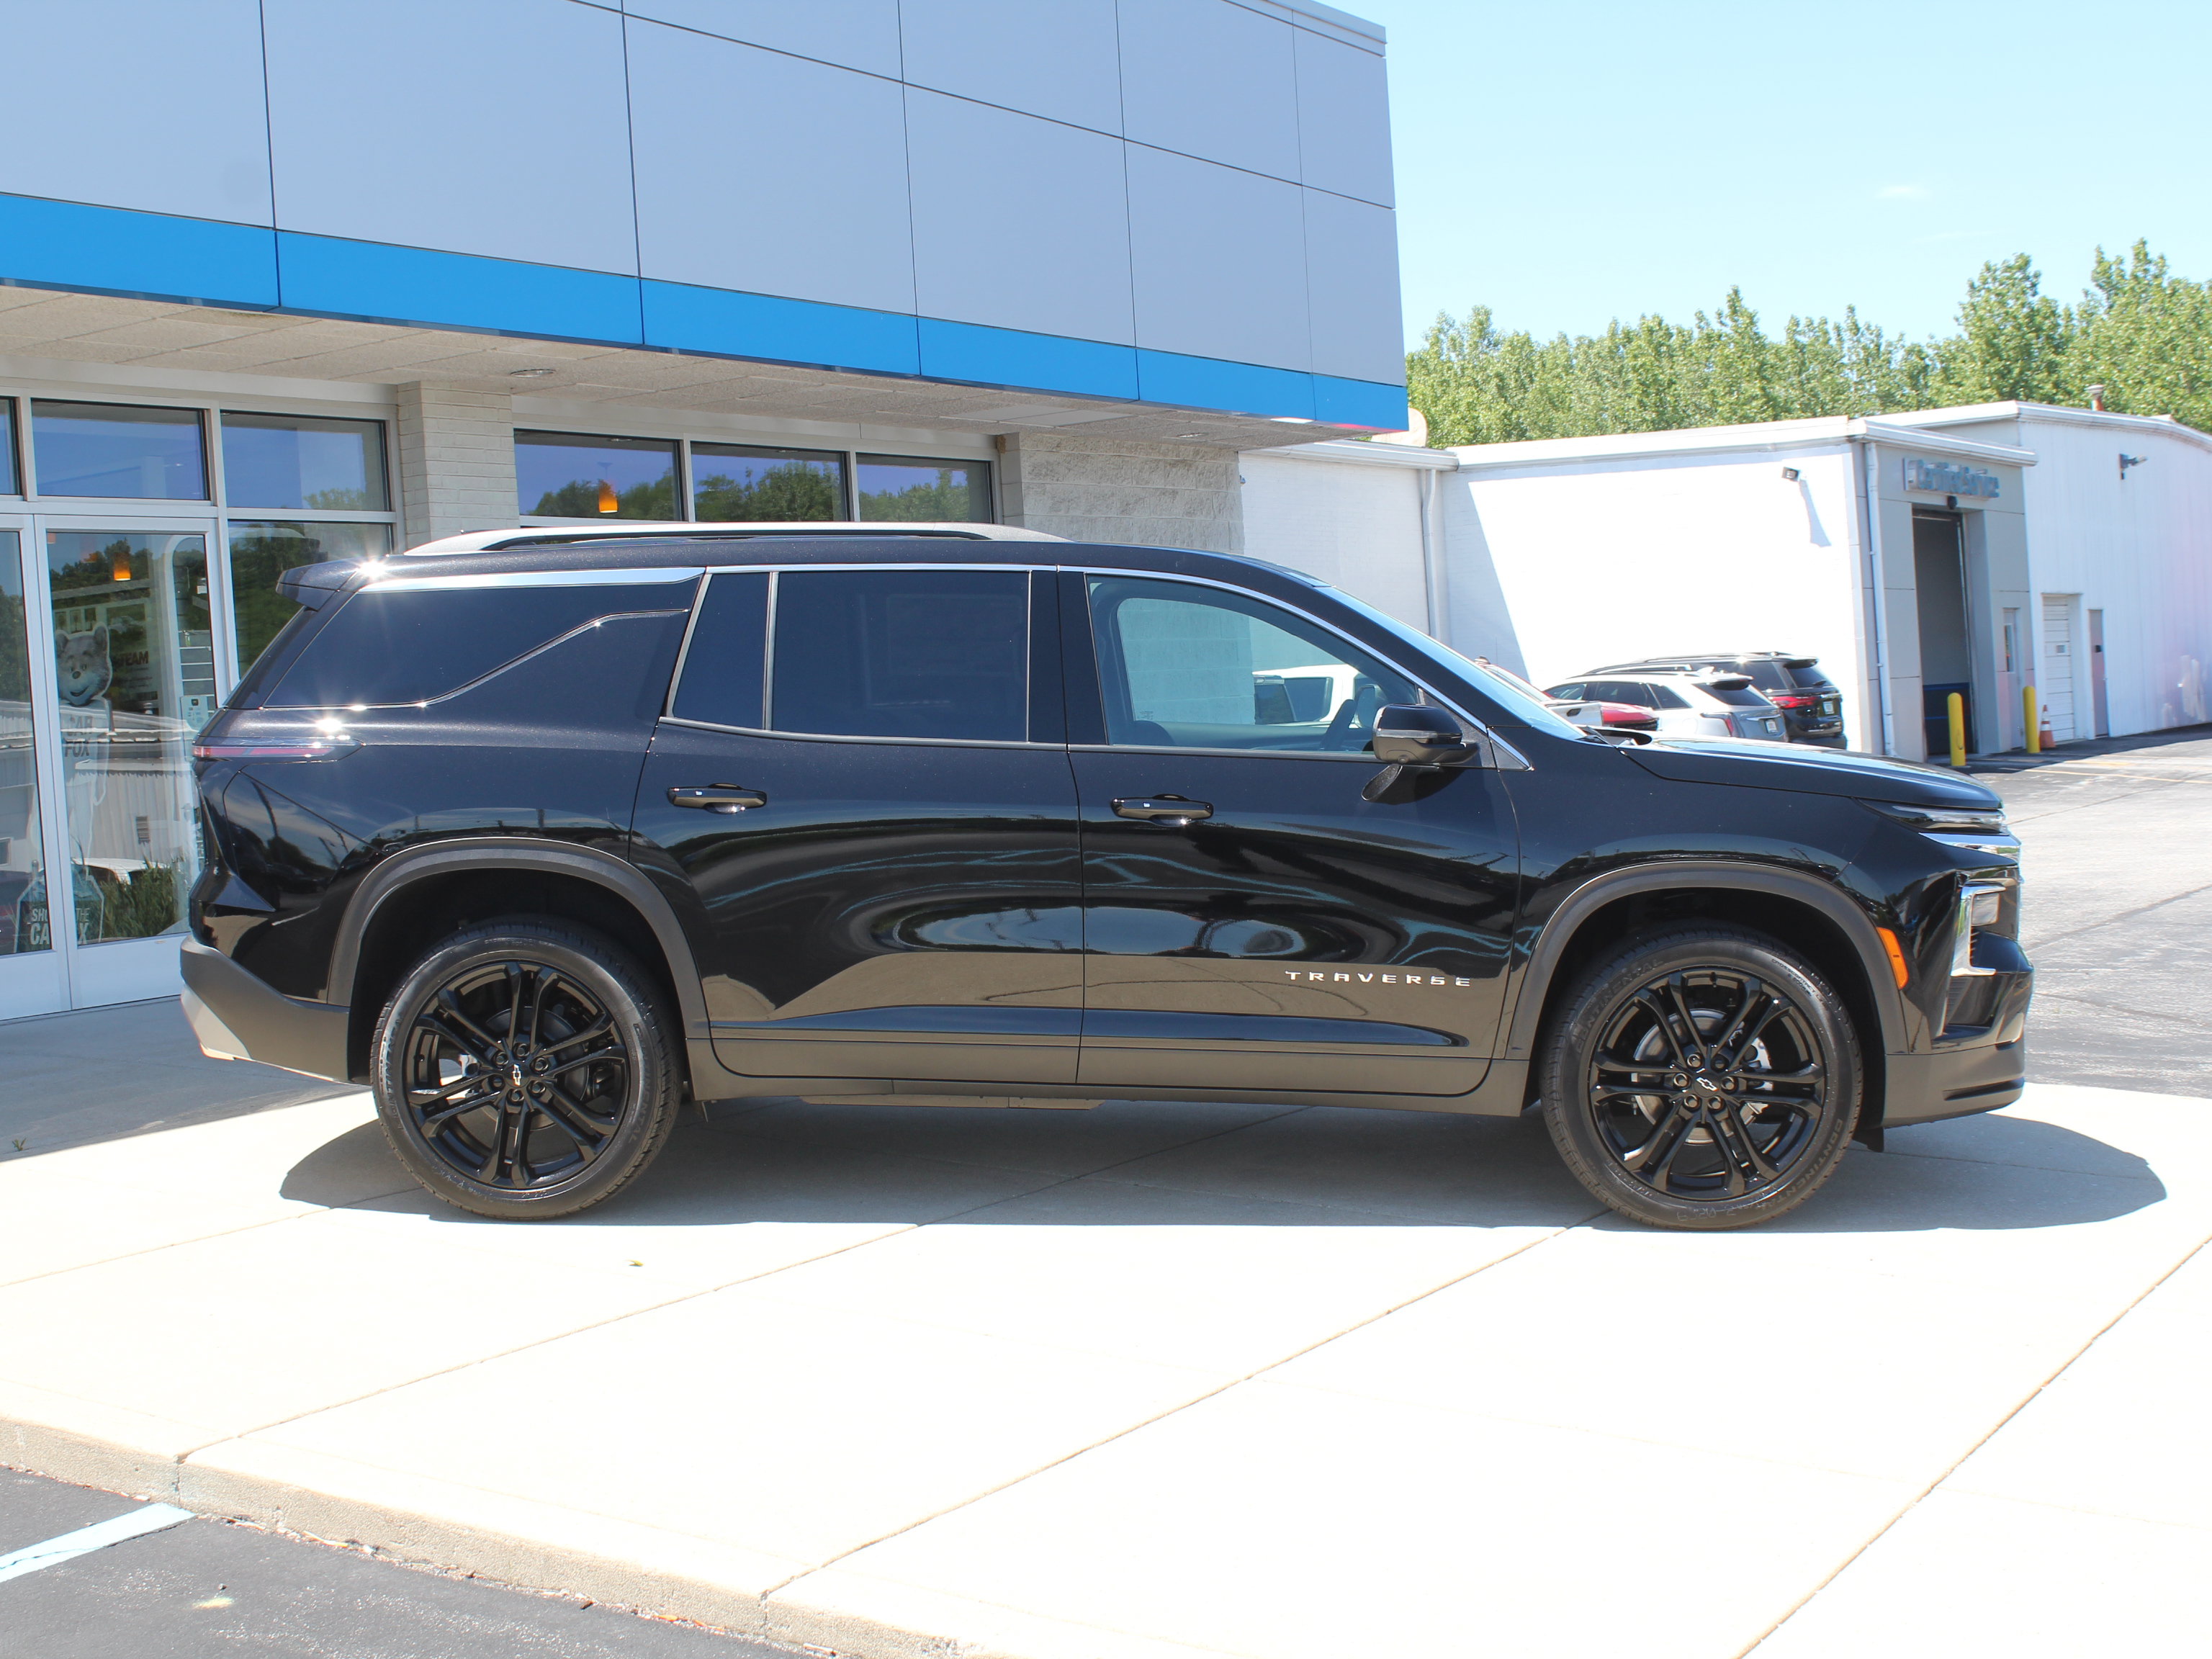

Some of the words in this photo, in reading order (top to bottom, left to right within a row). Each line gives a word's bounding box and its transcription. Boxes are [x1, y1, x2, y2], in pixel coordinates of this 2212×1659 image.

[65, 739, 90, 757] FOX
[1285, 970, 1470, 987] TRAVERSE
[1758, 1118, 1843, 1210] CONTINENTAL
